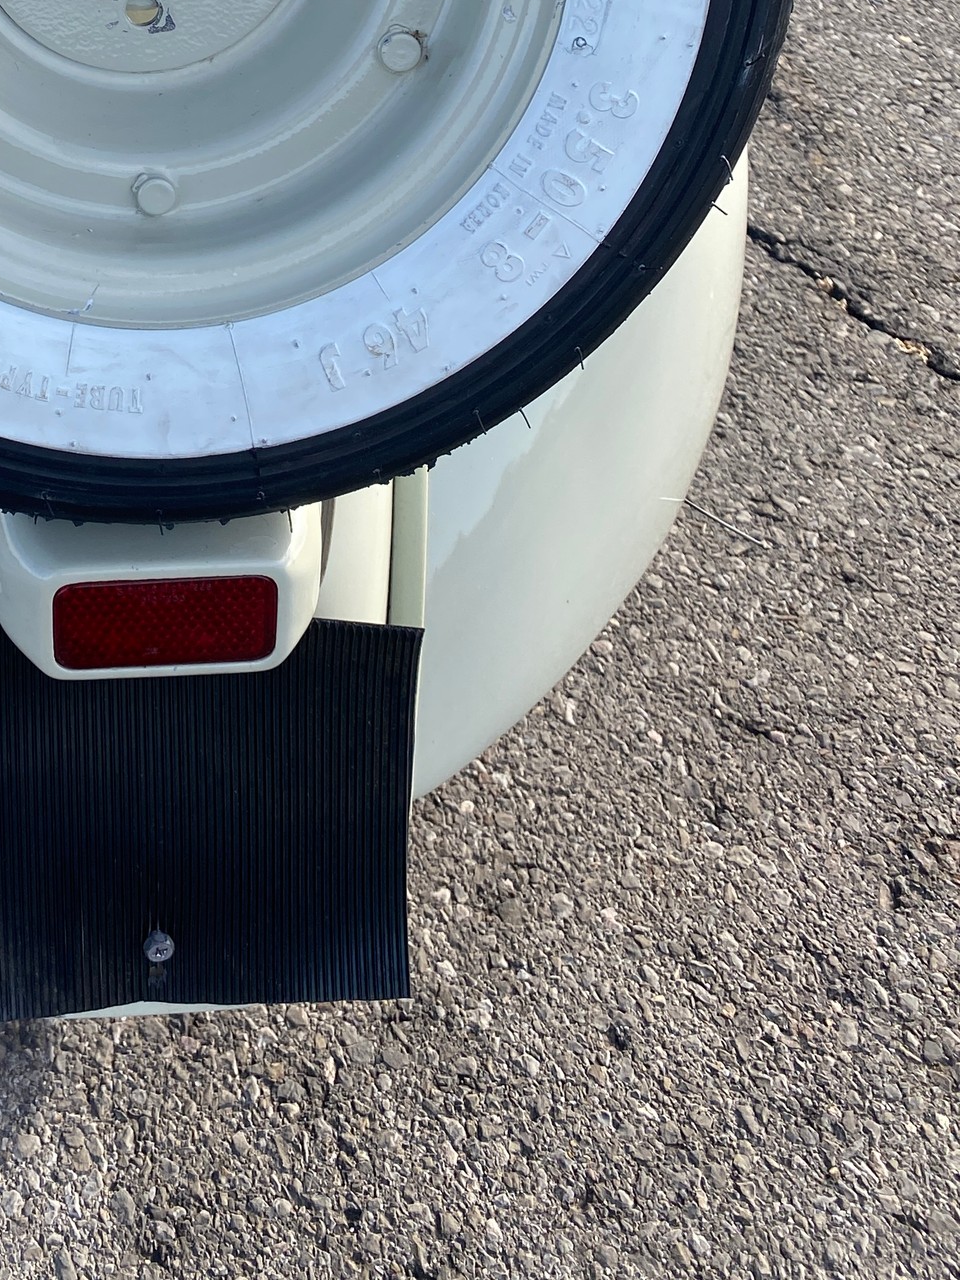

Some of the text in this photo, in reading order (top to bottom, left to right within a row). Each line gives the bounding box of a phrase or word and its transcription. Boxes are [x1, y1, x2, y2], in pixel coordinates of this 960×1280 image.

[458, 91, 568, 234] MADE IN KOREA
